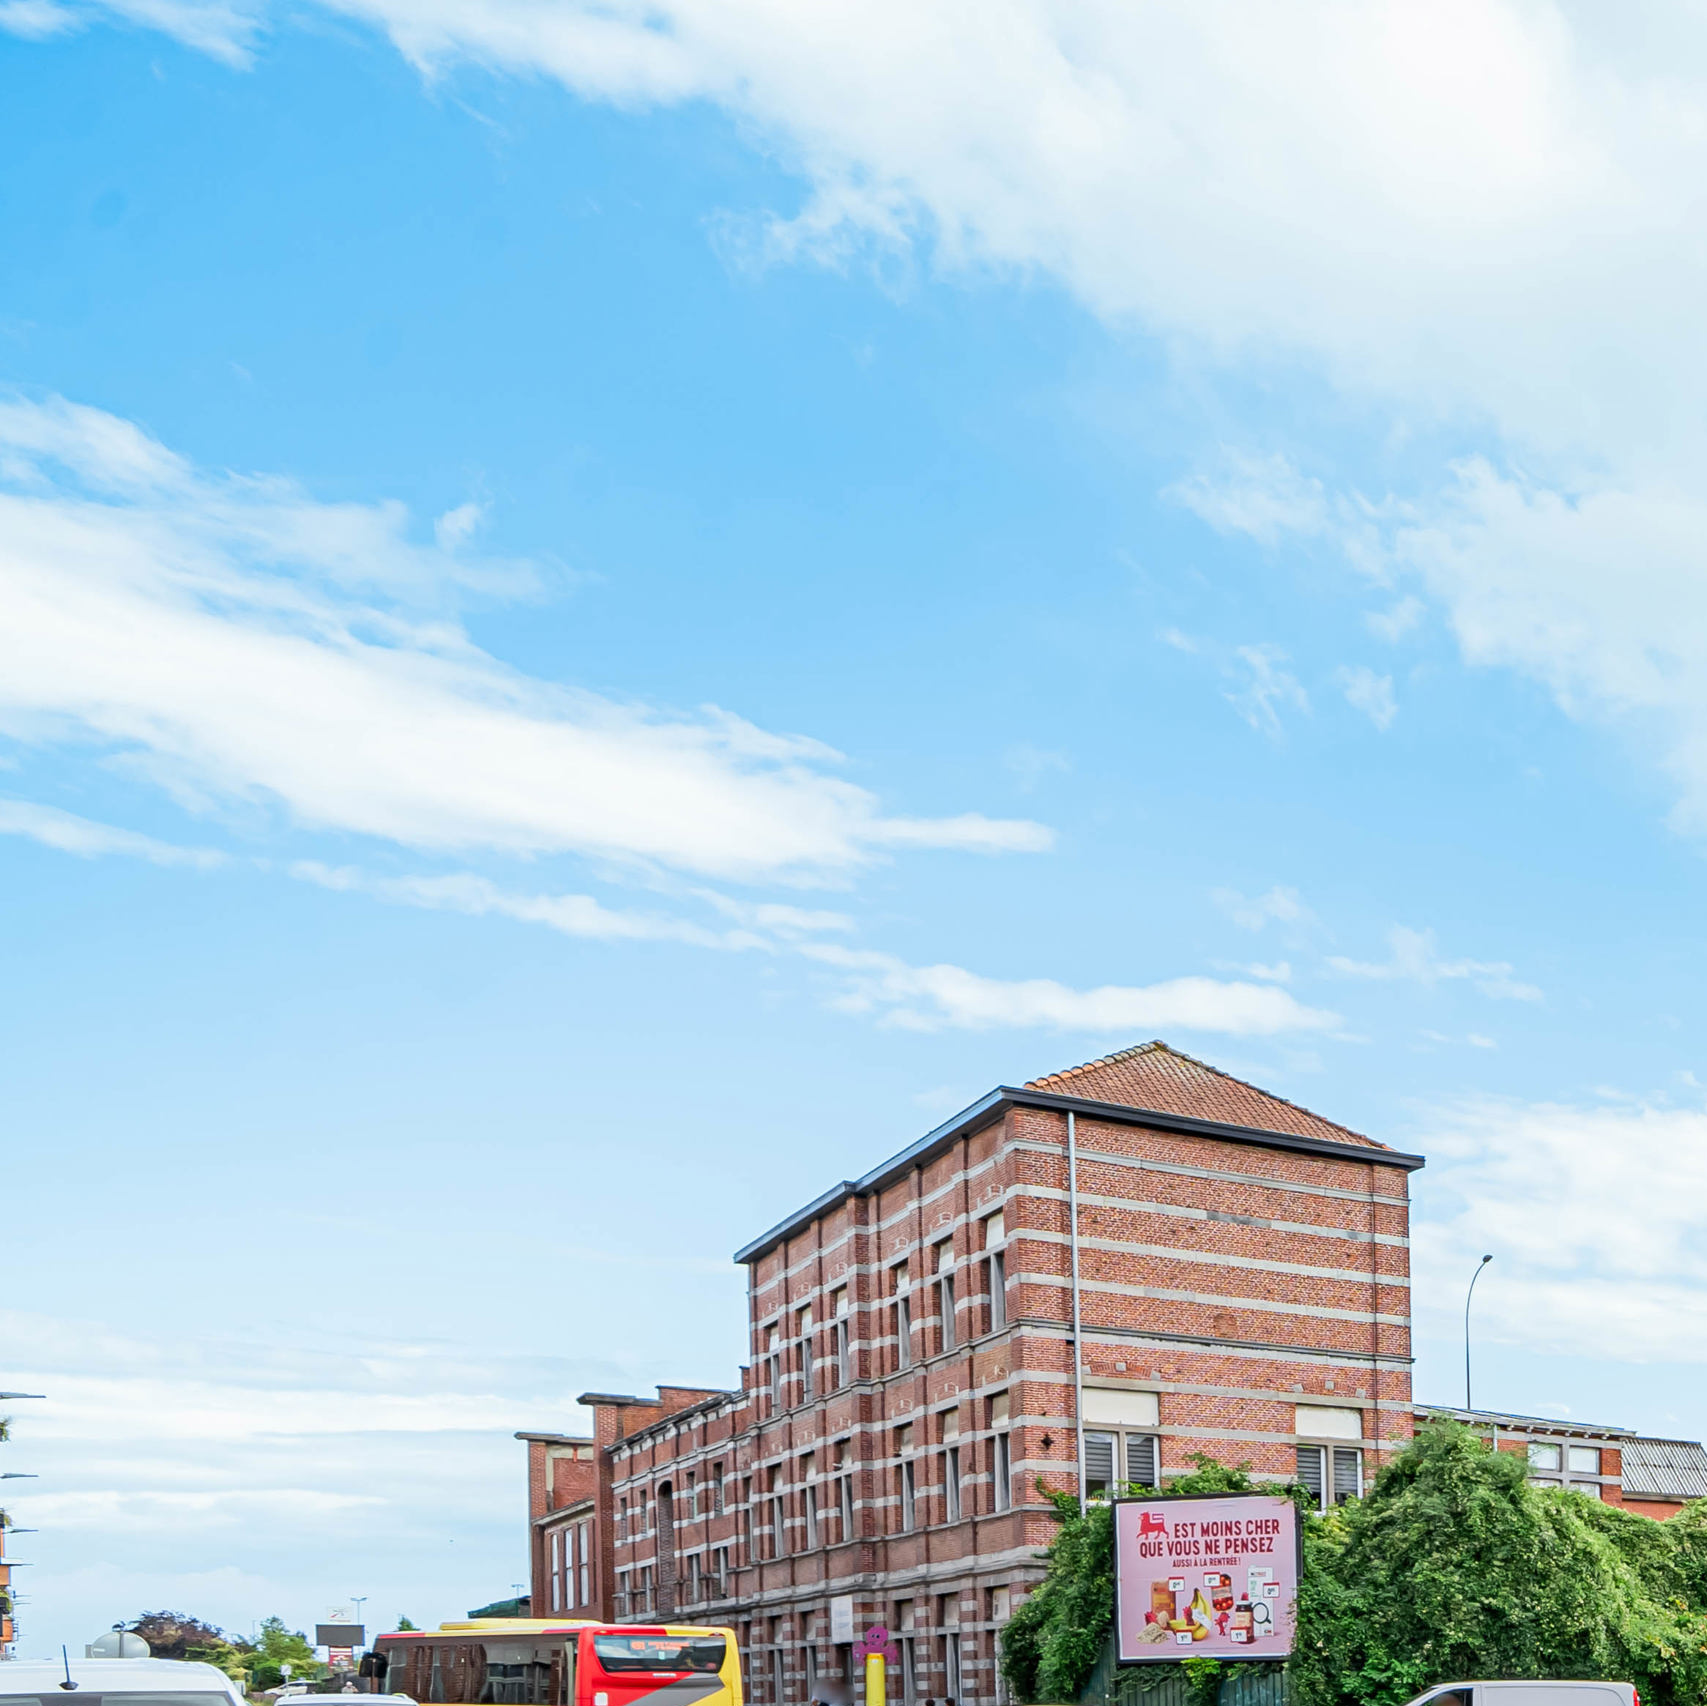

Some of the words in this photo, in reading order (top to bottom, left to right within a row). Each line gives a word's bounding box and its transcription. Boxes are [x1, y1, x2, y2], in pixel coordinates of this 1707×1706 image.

[1174, 1522, 1196, 1538] EST
[1200, 1520, 1242, 1537] MOINS
[1246, 1519, 1280, 1535] CHER
[1140, 1541, 1163, 1558] QUE
[1167, 1540, 1200, 1556] VOUS
[1205, 1538, 1220, 1555] NE
[1225, 1537, 1273, 1554] PENSEZ
[1172, 1558, 1192, 1568] AUSSI
[1199, 1558, 1207, 1567] LA
